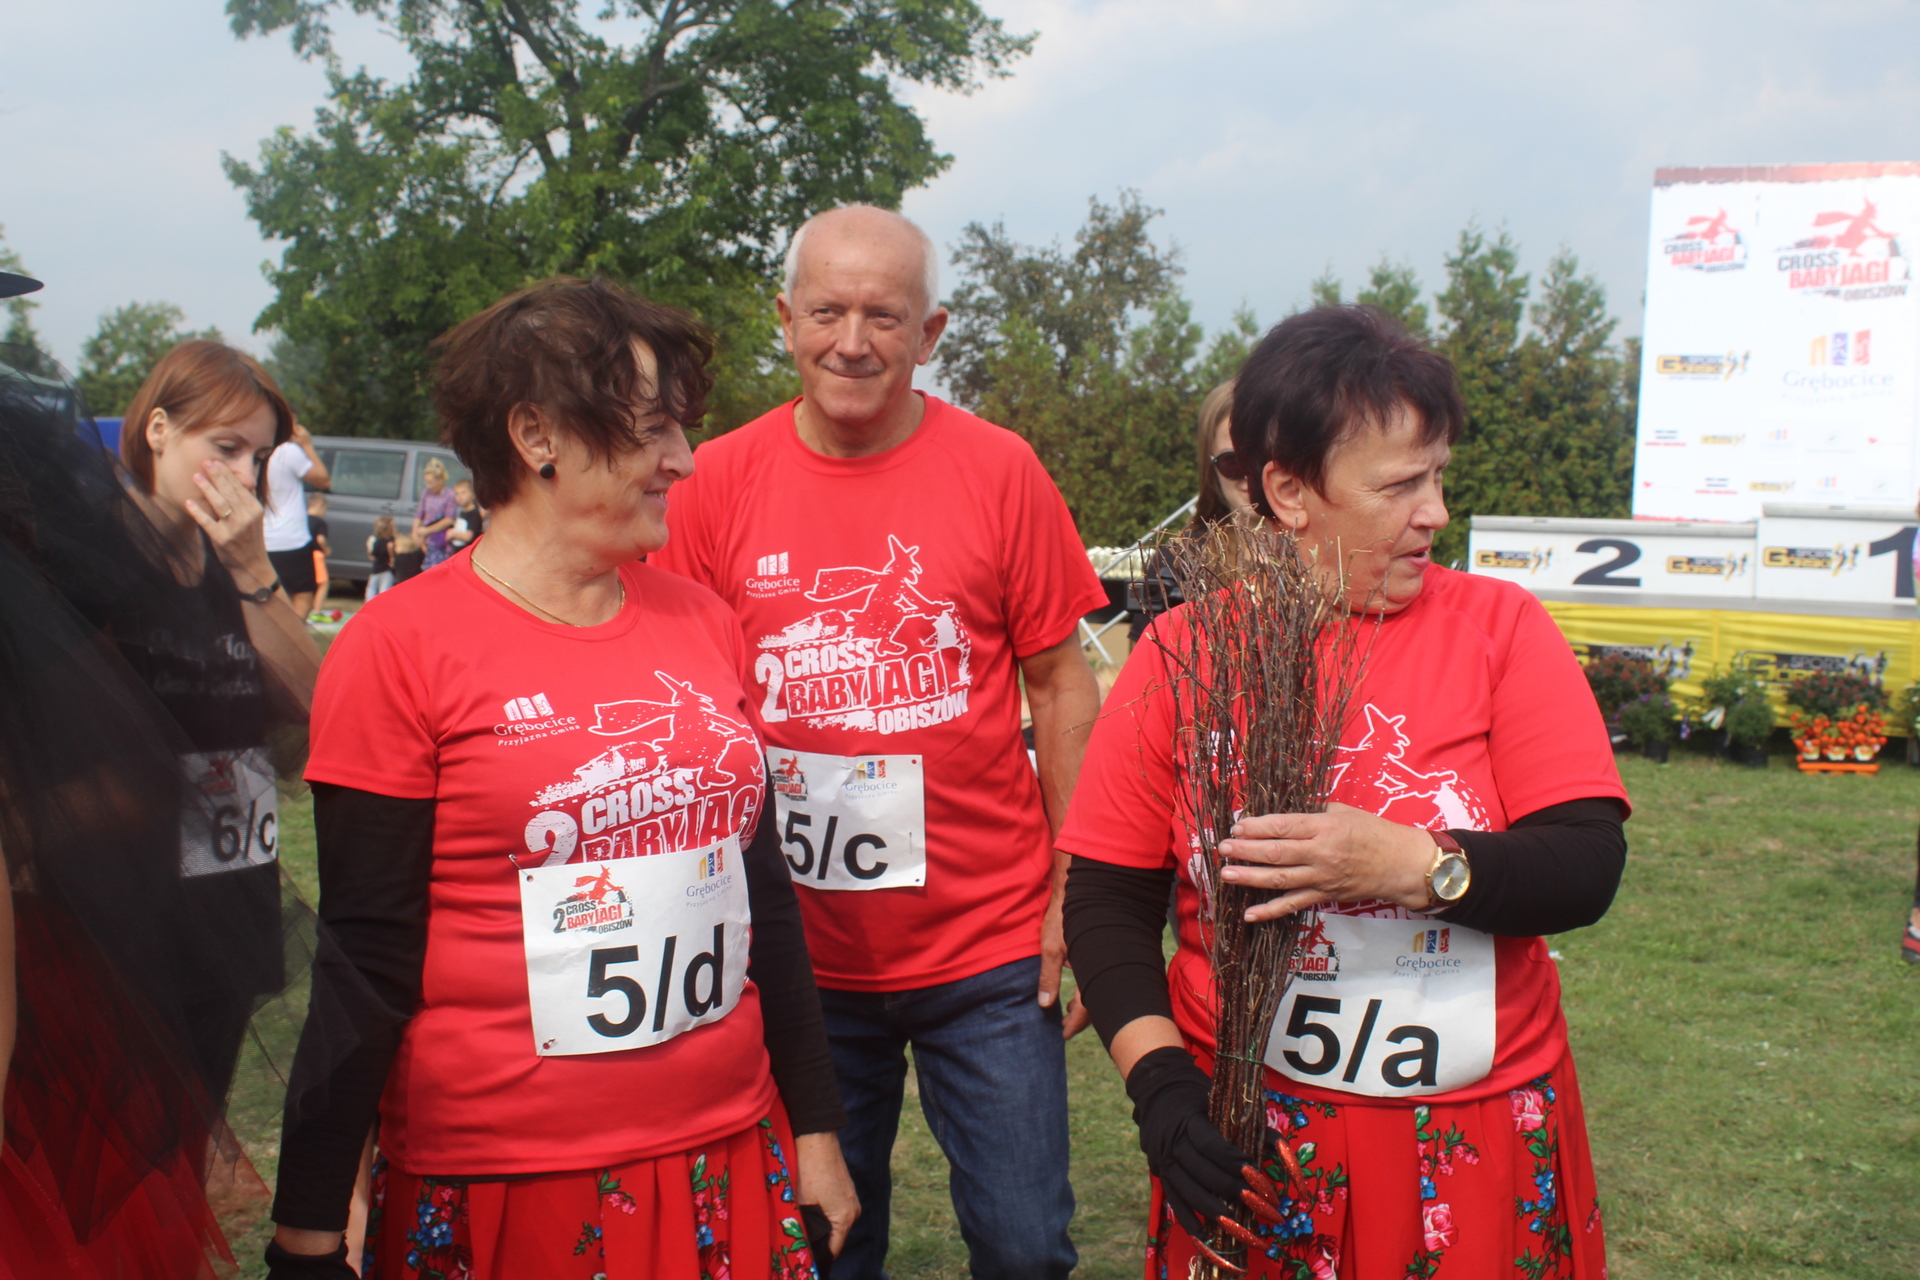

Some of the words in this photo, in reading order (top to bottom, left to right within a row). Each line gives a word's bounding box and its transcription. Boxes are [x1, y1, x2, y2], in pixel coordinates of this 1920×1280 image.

[1776, 251, 1837, 271] CROSS
[1572, 538, 1641, 588] 2
[1868, 526, 1918, 599] 1
[746, 577, 800, 594] Grębocice
[785, 640, 875, 679] CROSS
[755, 652, 788, 723] 2
[494, 715, 577, 738] Grębocice
[877, 688, 969, 735] OBISZÓW
[497, 732, 548, 747] Przyjazna
[550, 723, 581, 738] Gmina
[581, 769, 697, 836] CROSS
[845, 780, 898, 794] Grębocice
[211, 799, 276, 863] 6/c
[524, 810, 579, 868] 2
[784, 810, 889, 881] 5/c
[686, 874, 732, 898] Grębocice
[552, 908, 567, 934] 2
[566, 900, 597, 916] CROSS
[599, 918, 633, 935] OBISZÓW
[1302, 972, 1338, 982] OBISZÓW
[1396, 954, 1461, 973] Grębocice
[586, 922, 725, 1039] 5/d
[1281, 993, 1440, 1089] 5/a
